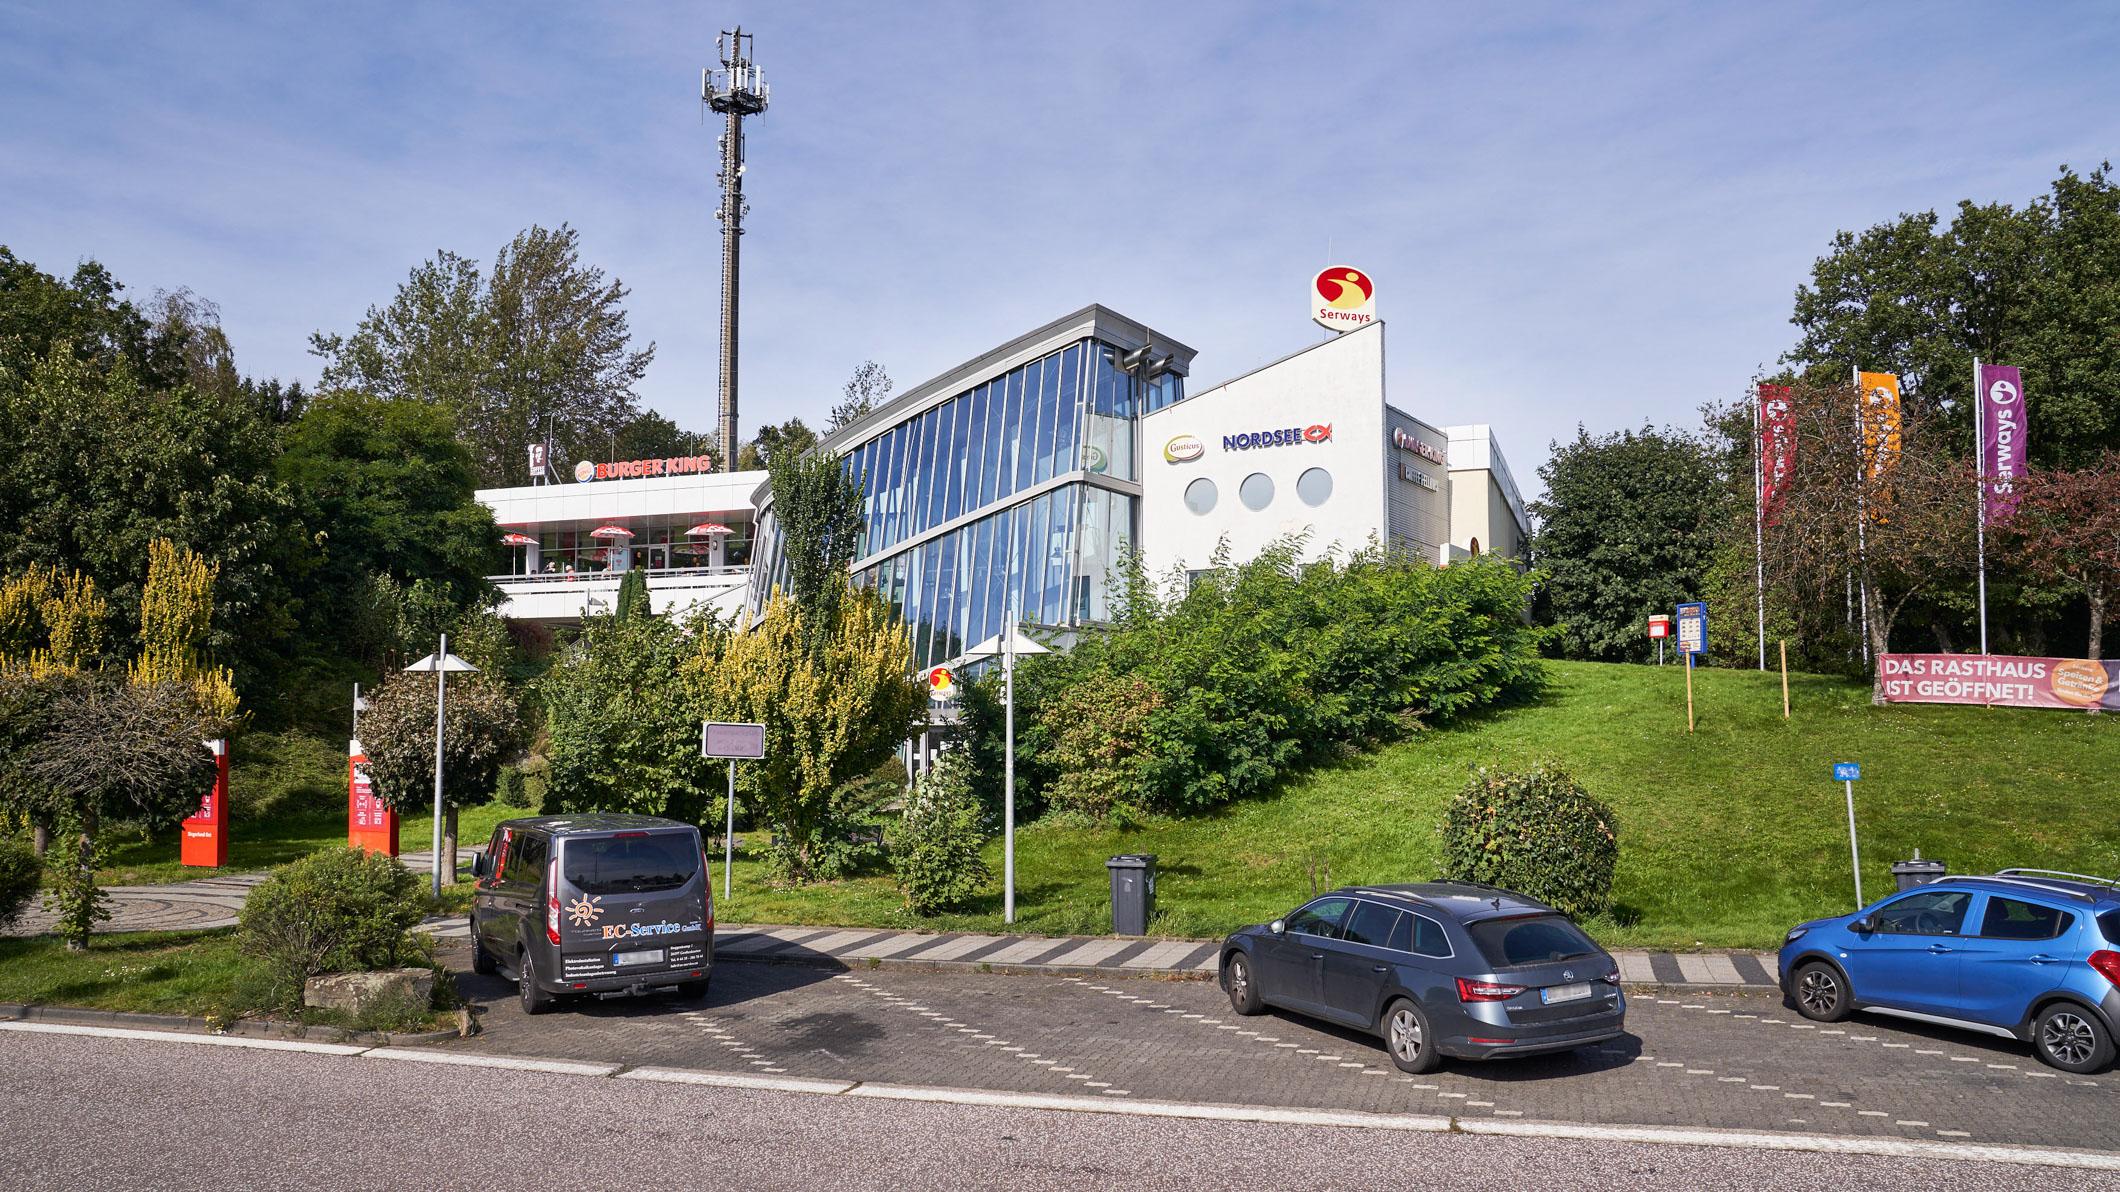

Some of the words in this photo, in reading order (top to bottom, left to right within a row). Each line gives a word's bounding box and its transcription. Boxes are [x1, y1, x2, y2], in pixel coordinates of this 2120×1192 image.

[1320, 308, 1371, 324] Serways
[1170, 443, 1200, 453] Gusticus
[1223, 428, 1302, 451] NORDSEE
[596, 458, 664, 480] BURGER
[666, 454, 712, 473] KING
[1885, 659, 1926, 675] DAS
[1931, 659, 2046, 679] RASTHAUS
[1886, 680, 1913, 696] IST
[1917, 678, 2034, 700] GEÖFFNET!
[602, 920, 681, 940] EC-Service
